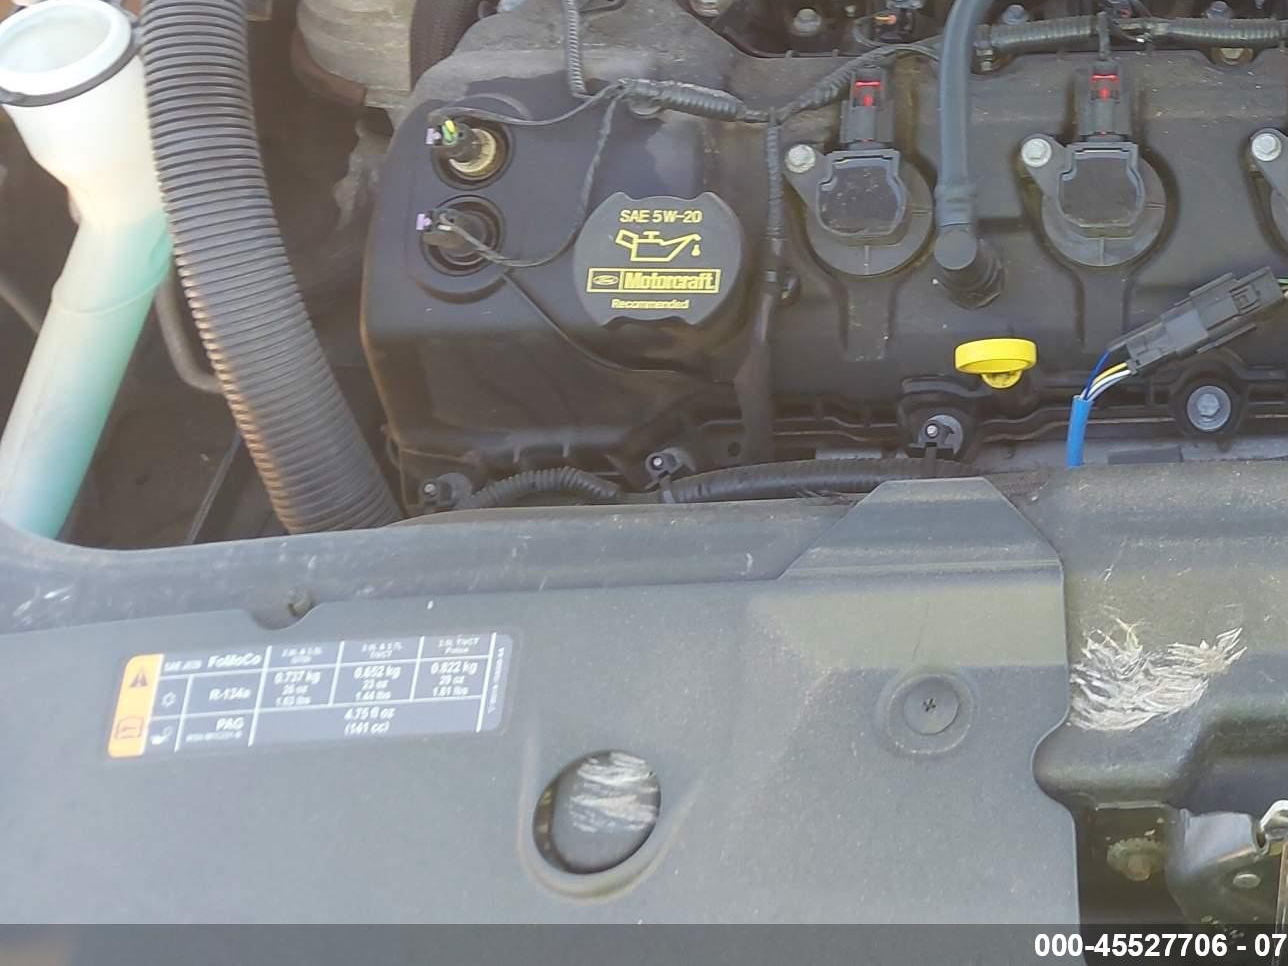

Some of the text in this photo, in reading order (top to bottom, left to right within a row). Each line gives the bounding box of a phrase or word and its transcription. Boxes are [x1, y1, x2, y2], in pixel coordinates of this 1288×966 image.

[620, 209, 703, 223] SAE 5W-20
[624, 272, 715, 289] Motorcraft
[611, 299, 690, 309] Recommended
[207, 653, 262, 668] FoMoCo
